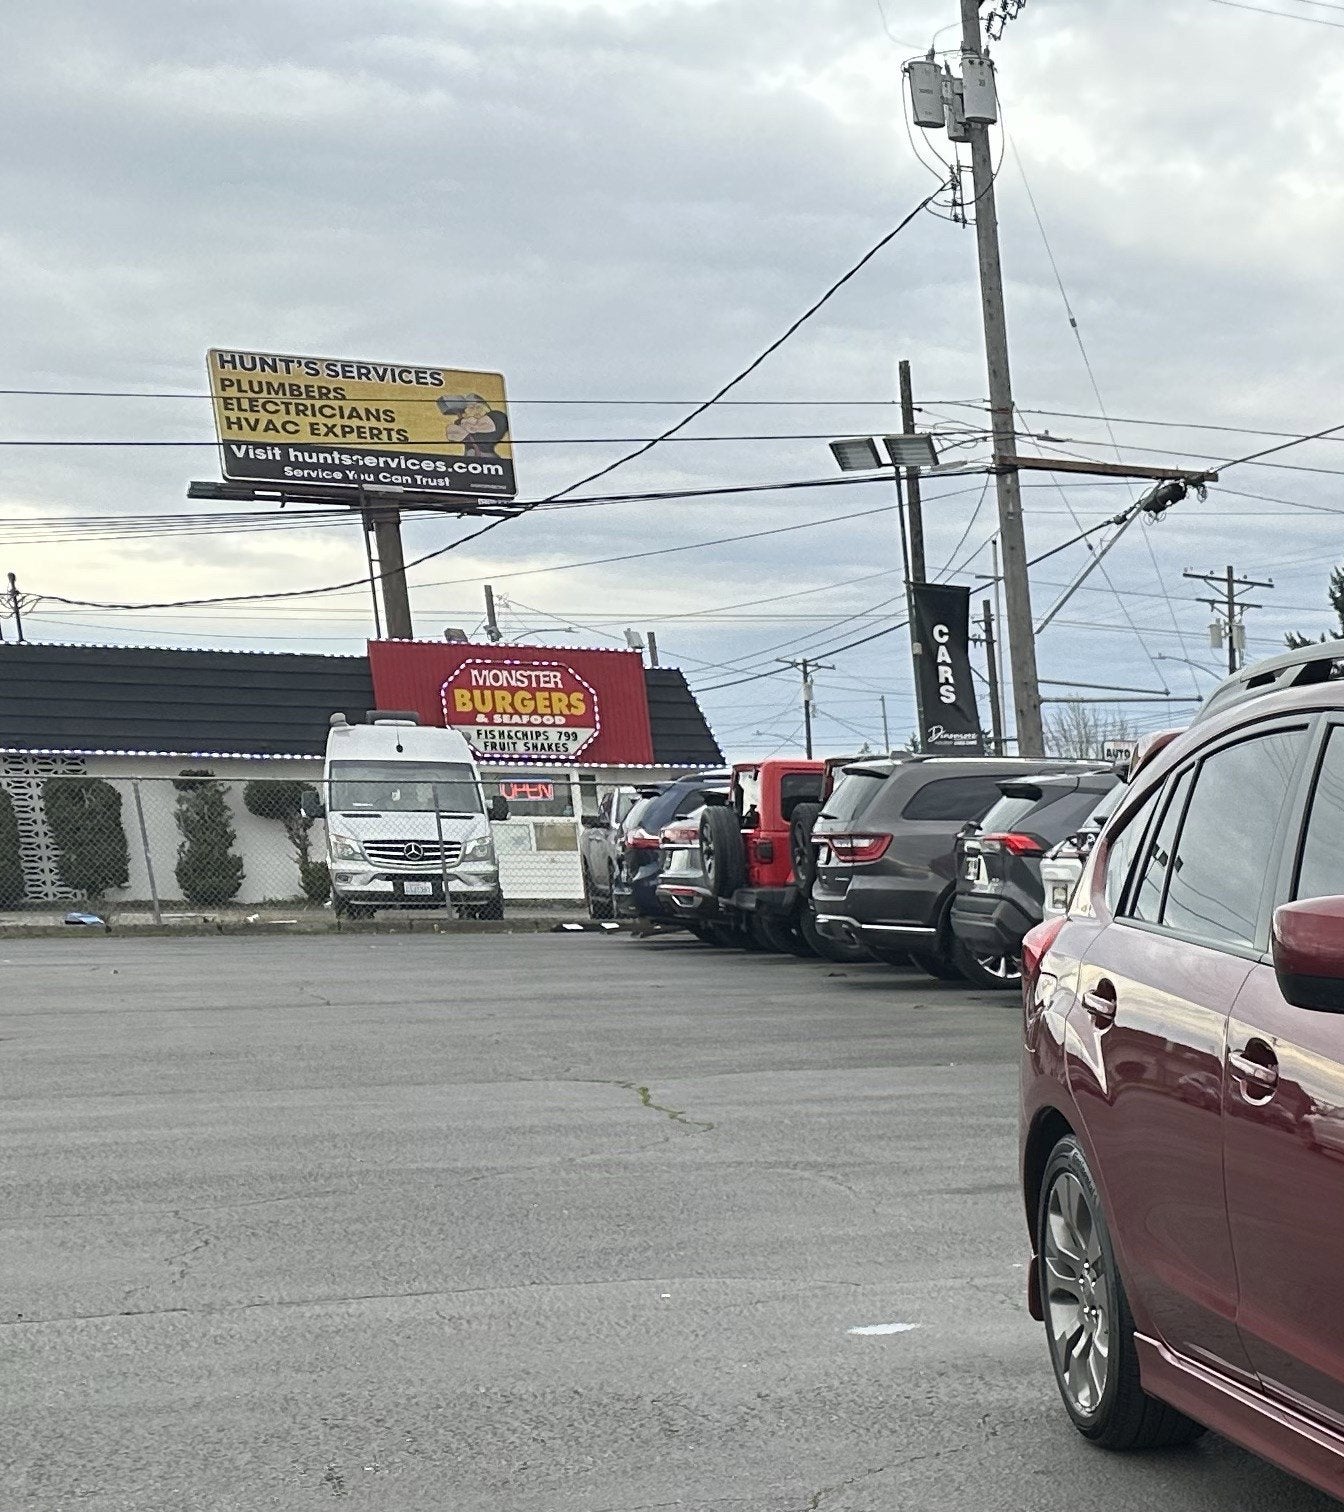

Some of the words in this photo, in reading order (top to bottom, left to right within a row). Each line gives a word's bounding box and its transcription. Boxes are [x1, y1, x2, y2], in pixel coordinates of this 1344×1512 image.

[217, 353, 321, 377] HUNT'S
[325, 362, 444, 387] SERVICES
[220, 377, 347, 400] PLUMBERS
[222, 397, 396, 423] ELECTRICIANS
[225, 416, 300, 435] HVAC
[309, 422, 409, 442] EXPERTS
[230, 444, 281, 461] Visit
[284, 466, 343, 480] Service
[379, 472, 412, 484] Can
[414, 475, 450, 487] Trust
[932, 624, 956, 704] CARS
[470, 669, 563, 688] MONSTER
[453, 688, 586, 716] BURGERS
[475, 715, 488, 723] &
[493, 715, 566, 725] SEAFOOD
[476, 729, 549, 741] FISH&CHIPS
[557, 731, 578, 741] 799
[483, 741, 517, 752] FRUIT
[524, 741, 569, 753] SHAKES
[501, 780, 553, 799] OPEN
